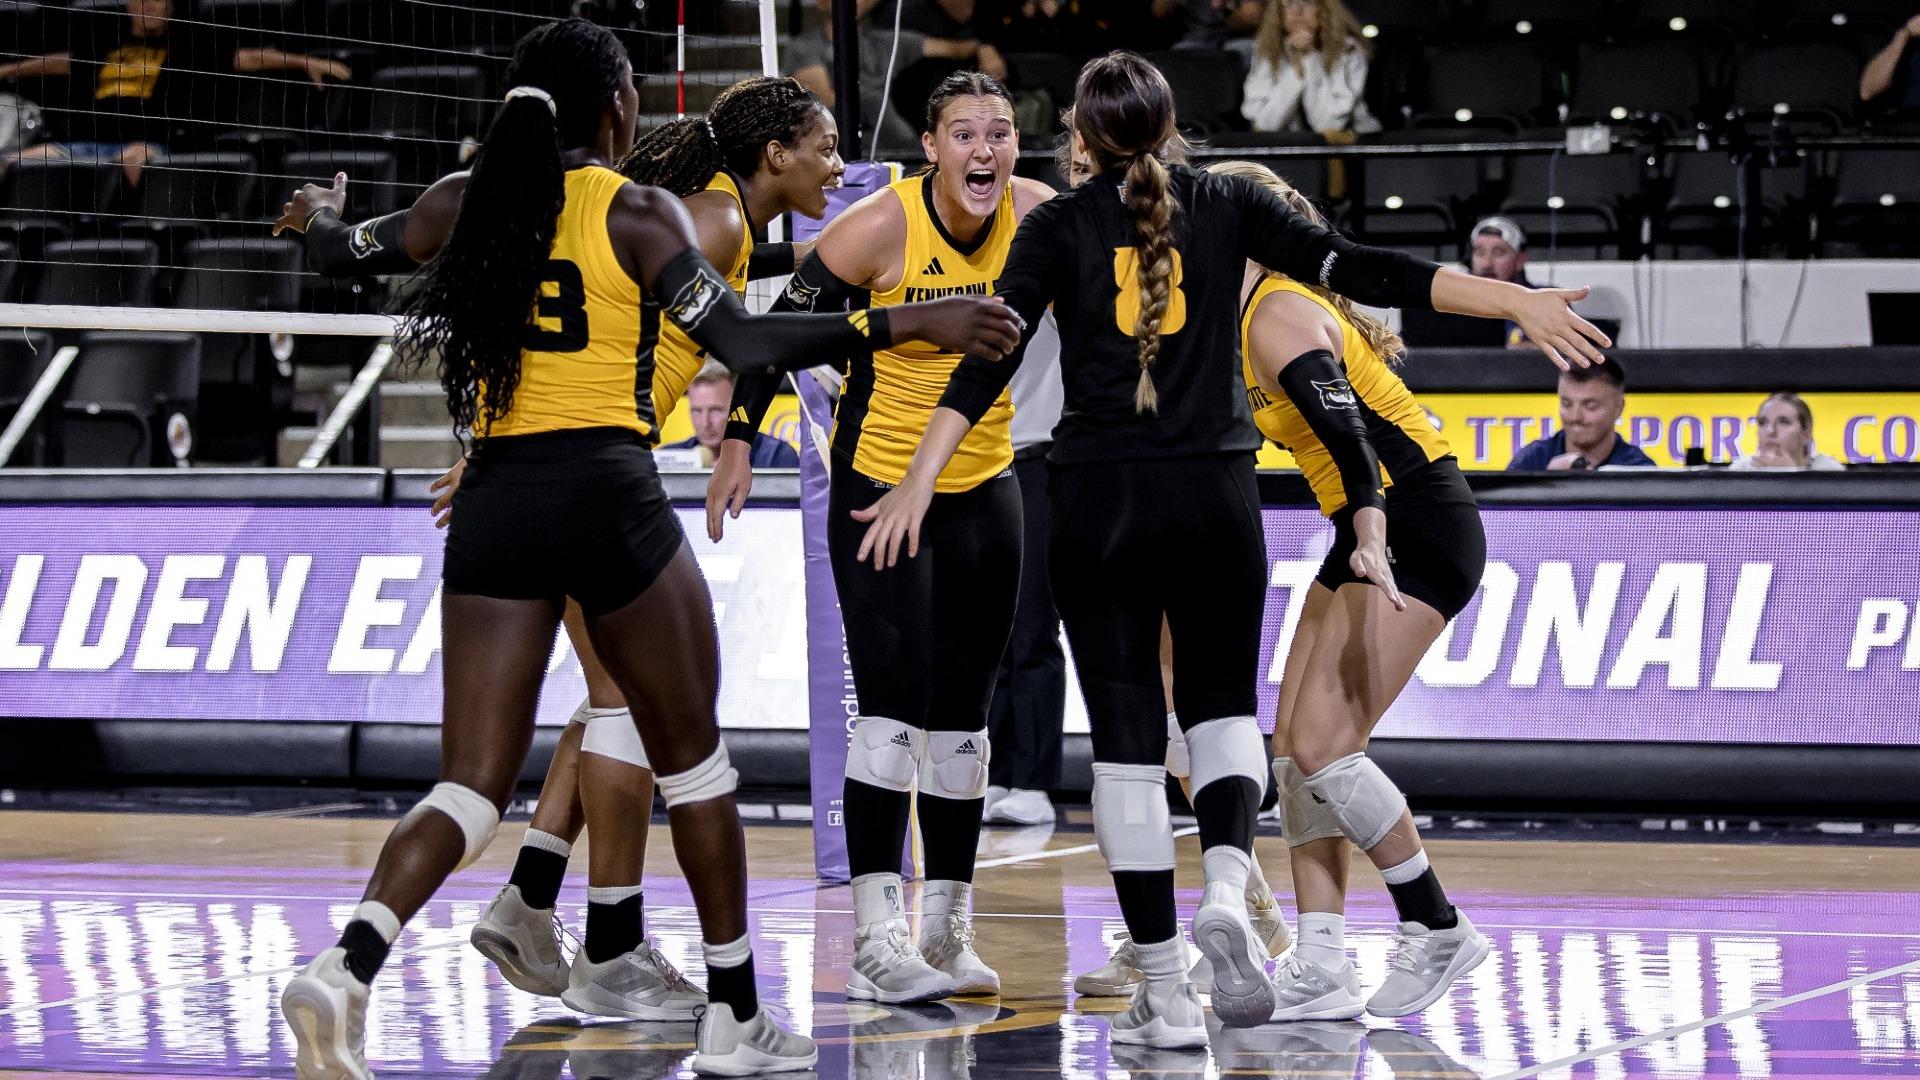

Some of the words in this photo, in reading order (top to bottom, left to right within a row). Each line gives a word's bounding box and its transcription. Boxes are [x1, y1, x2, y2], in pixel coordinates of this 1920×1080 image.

[1113, 247, 1187, 336] 8
[0, 553, 313, 673] LDEN
[890, 738, 911, 748] adidas
[955, 747, 978, 755] adidas
